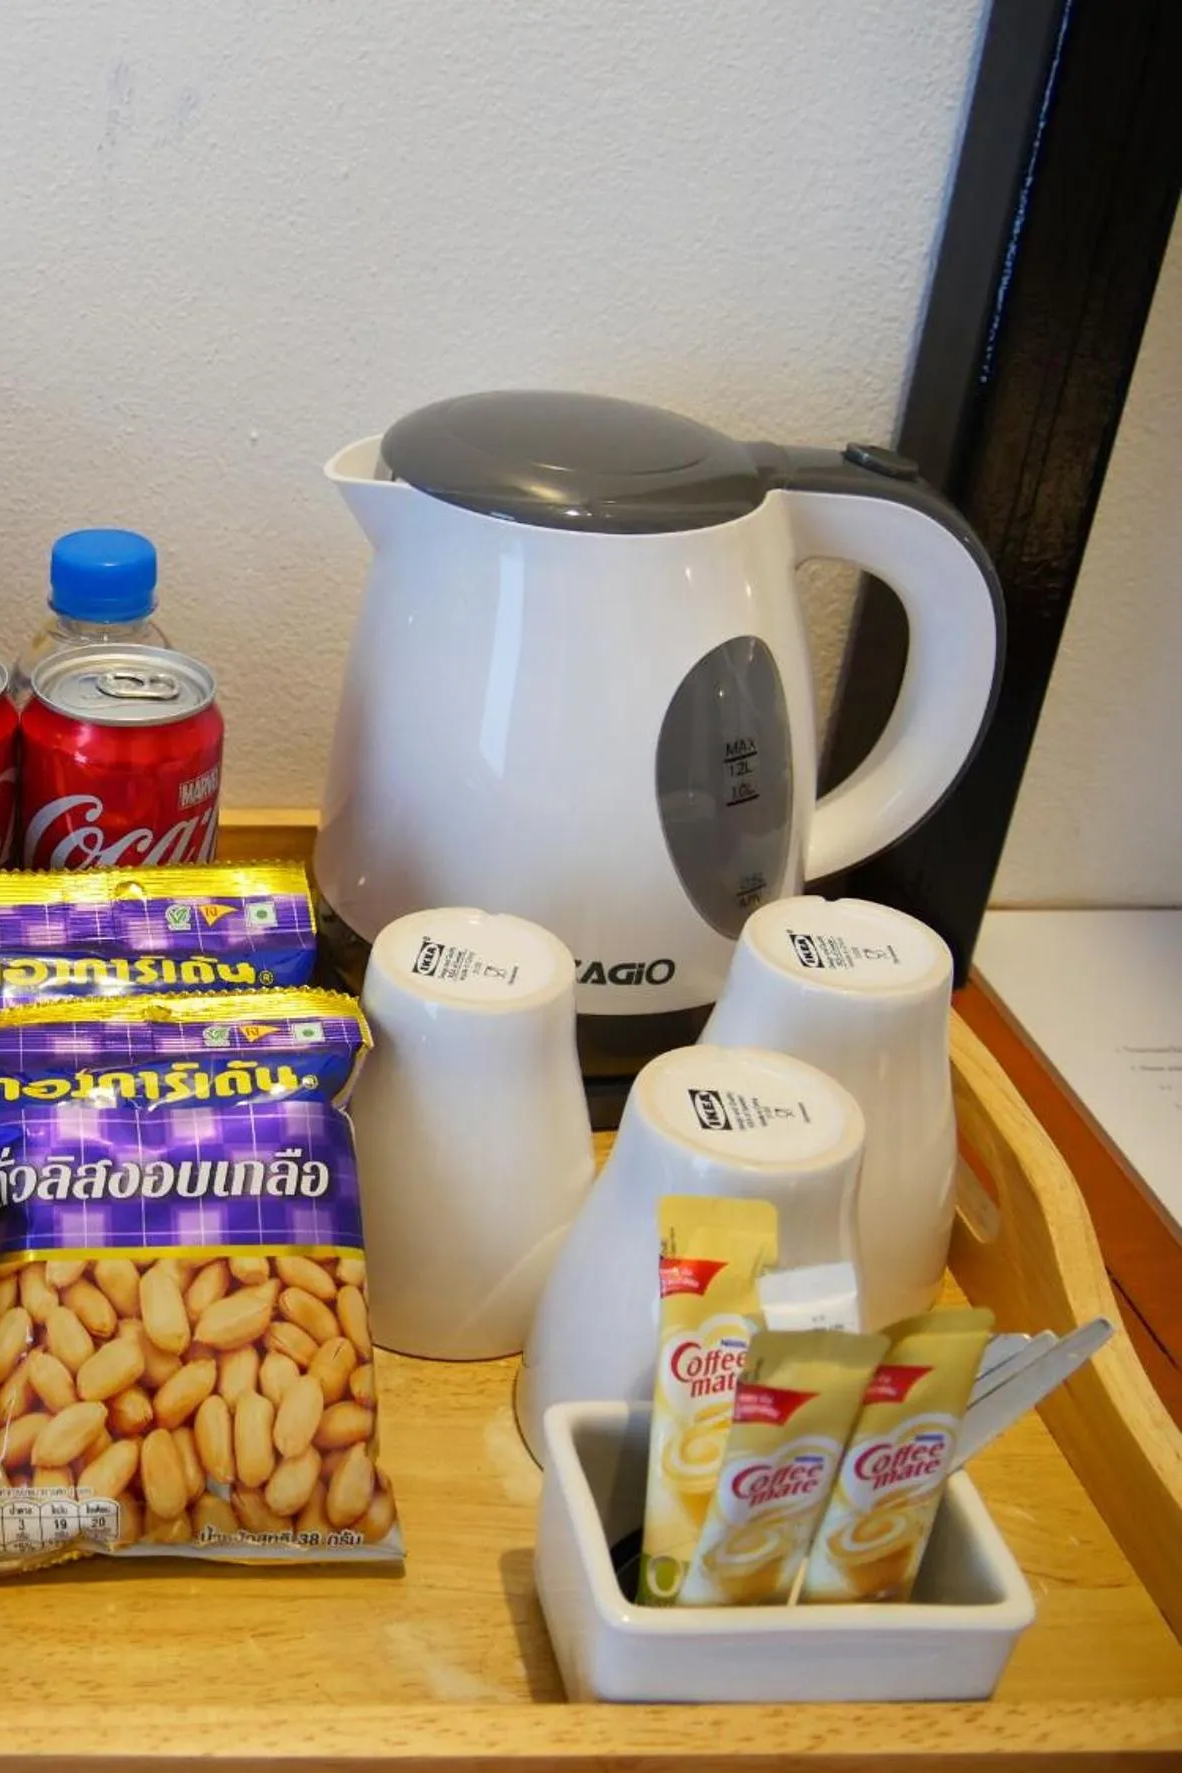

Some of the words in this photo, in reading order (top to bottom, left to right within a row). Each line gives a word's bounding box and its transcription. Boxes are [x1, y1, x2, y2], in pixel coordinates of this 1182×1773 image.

[574, 959, 676, 986] AGiO
[670, 1341, 747, 1384] Coffee
[689, 1372, 737, 1399] mat
[854, 1442, 946, 1481] Coffee
[872, 1458, 942, 1491] mate
[731, 1463, 824, 1499] Coffee
[748, 1477, 819, 1508] mate
[18, 1519, 26, 1531] 3
[54, 1518, 67, 1530] 19
[297, 1532, 320, 1546] 38
